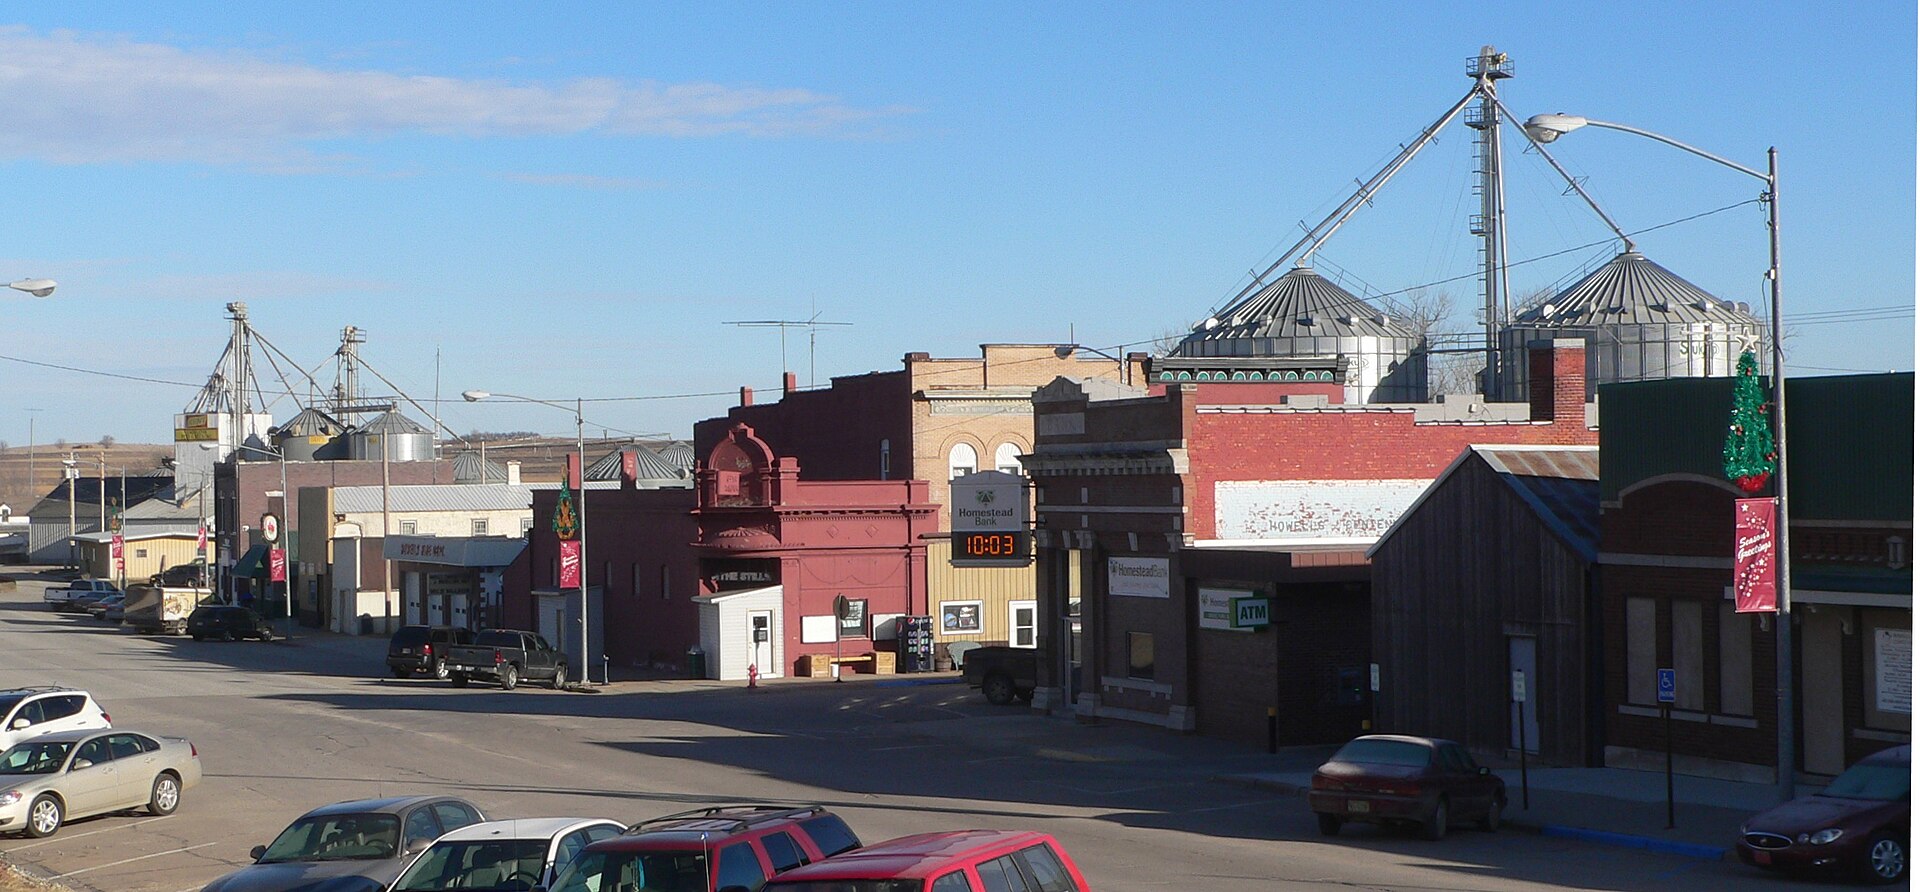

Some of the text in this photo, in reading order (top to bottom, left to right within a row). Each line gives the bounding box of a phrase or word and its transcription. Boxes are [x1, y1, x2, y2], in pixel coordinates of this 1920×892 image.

[959, 508, 1013, 517] Homestead
[975, 517, 997, 526] Bank
[967, 535, 1013, 555] 10:03
[1739, 529, 1770, 548] Season's
[1738, 541, 1772, 563] Greetings
[721, 571, 738, 581] THE
[1240, 605, 1266, 620] ATM
